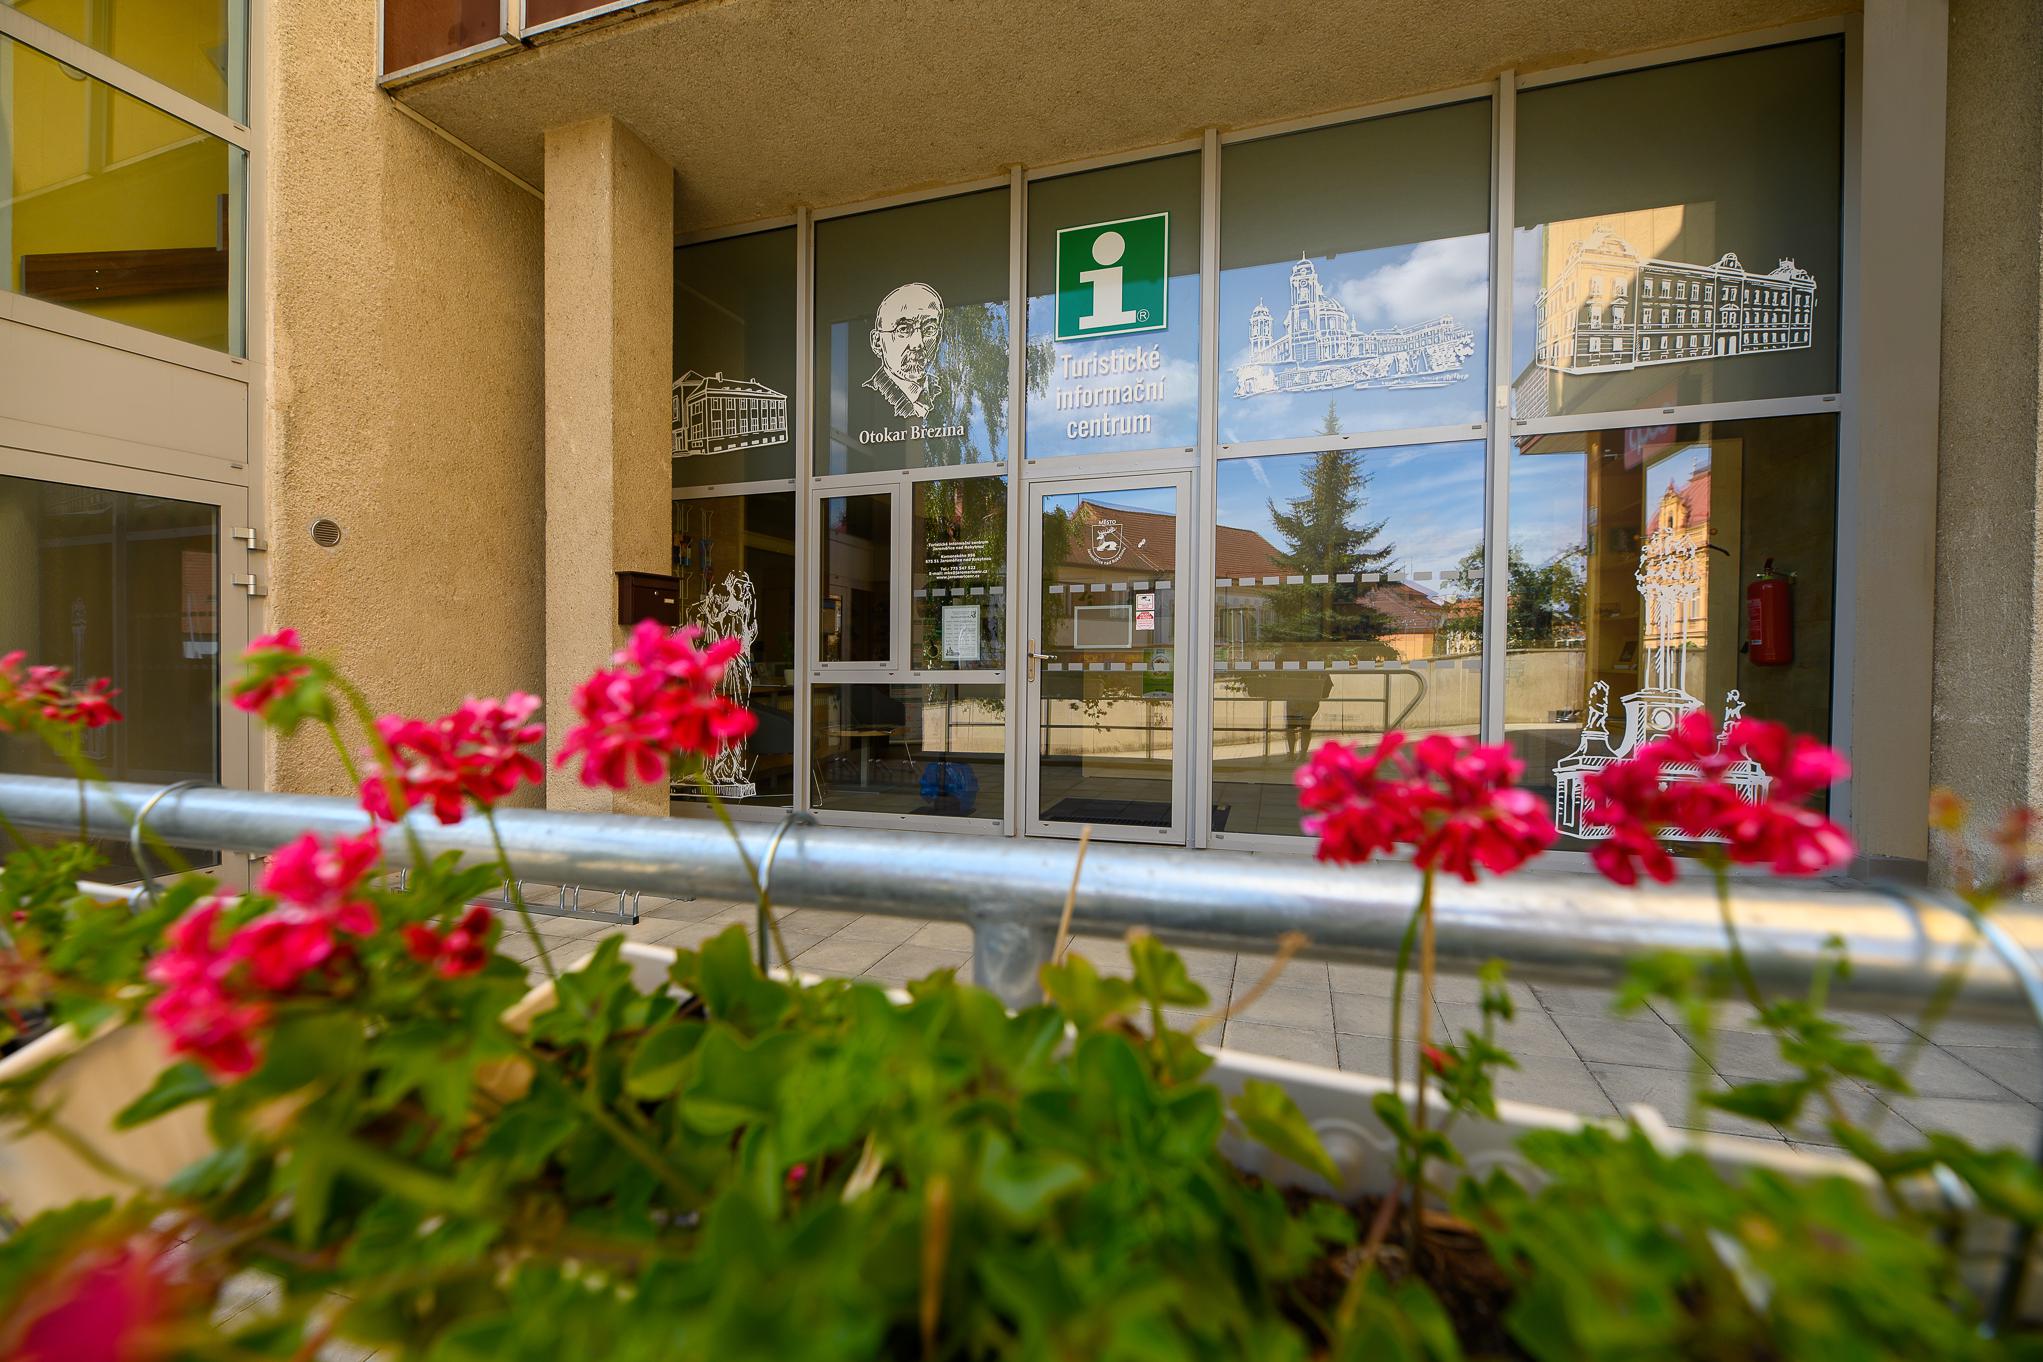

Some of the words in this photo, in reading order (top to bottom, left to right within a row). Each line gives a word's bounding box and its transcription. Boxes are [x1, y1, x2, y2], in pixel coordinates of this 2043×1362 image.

[1061, 344, 1161, 380] Turistické
[1056, 375, 1166, 411] informační
[859, 427, 907, 445] Otokar
[910, 424, 965, 440] Březina
[1067, 412, 1151, 440] centrum
